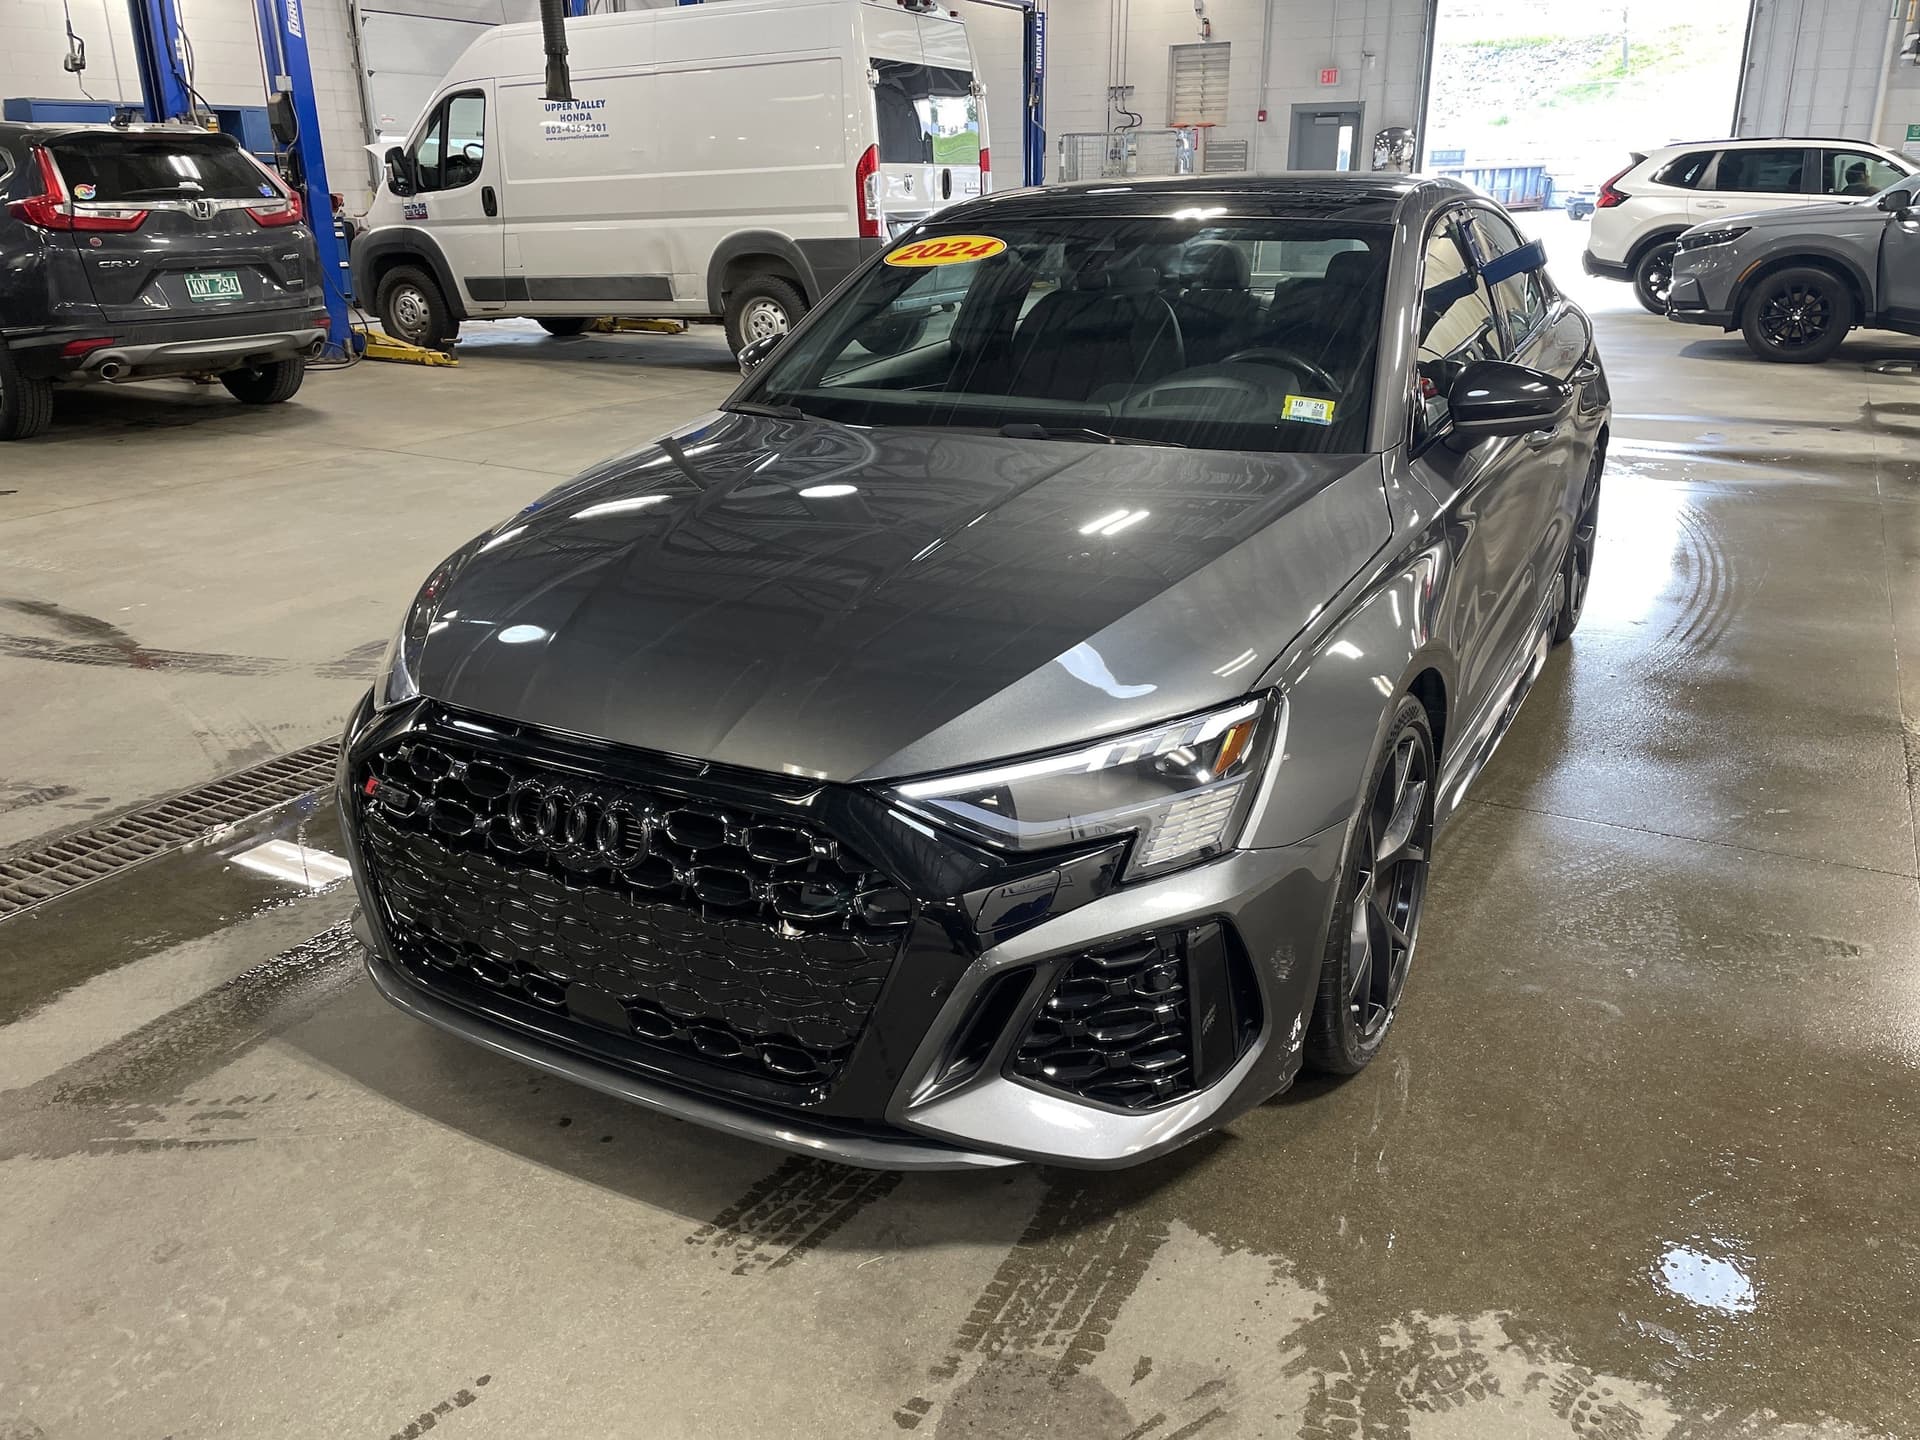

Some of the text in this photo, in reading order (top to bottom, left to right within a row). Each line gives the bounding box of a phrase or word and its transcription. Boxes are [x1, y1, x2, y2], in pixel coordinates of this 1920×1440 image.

[1321, 70, 1337, 84] EXIT
[545, 99, 606, 111] UPPER VALLEY
[560, 112, 592, 122] HONDA
[891, 241, 998, 262] 2024
[98, 260, 139, 268] CR-V
[217, 278, 237, 292] 294
